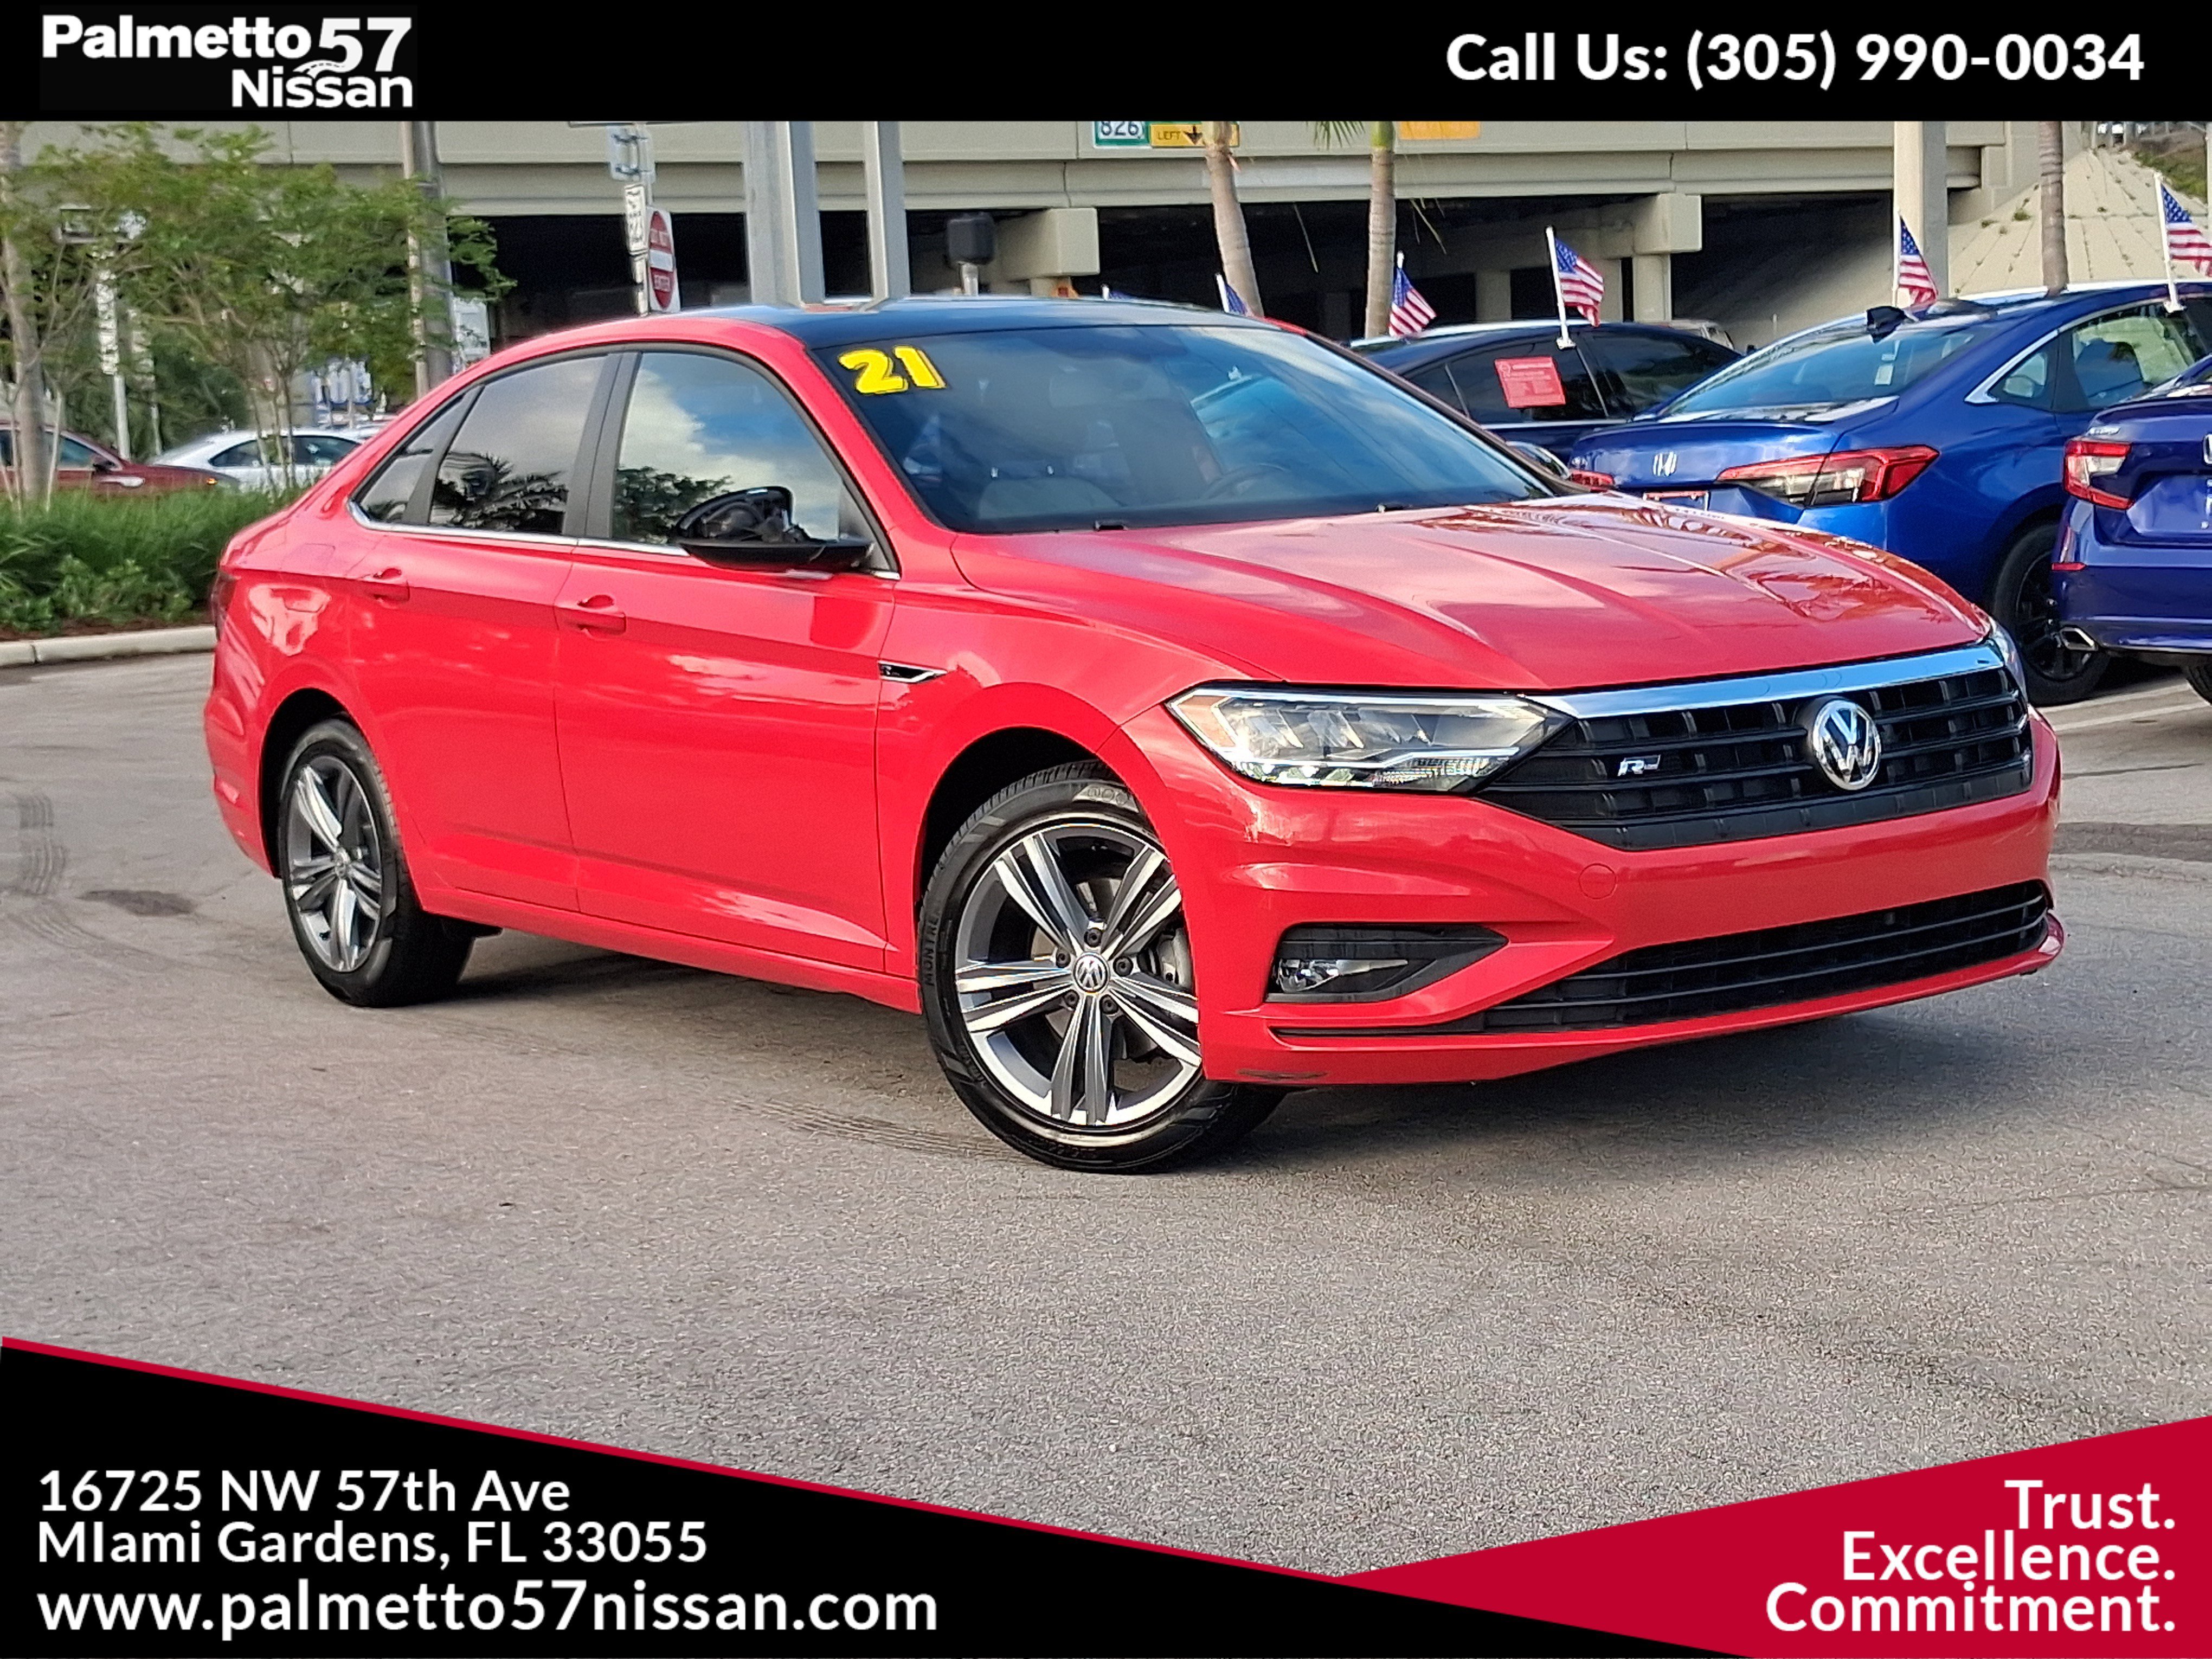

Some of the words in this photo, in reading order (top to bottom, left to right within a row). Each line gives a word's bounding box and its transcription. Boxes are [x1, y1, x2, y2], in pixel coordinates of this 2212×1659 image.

[1101, 121, 1140, 136] 826
[1157, 130, 1182, 141] LEFT
[838, 345, 947, 395] 21
